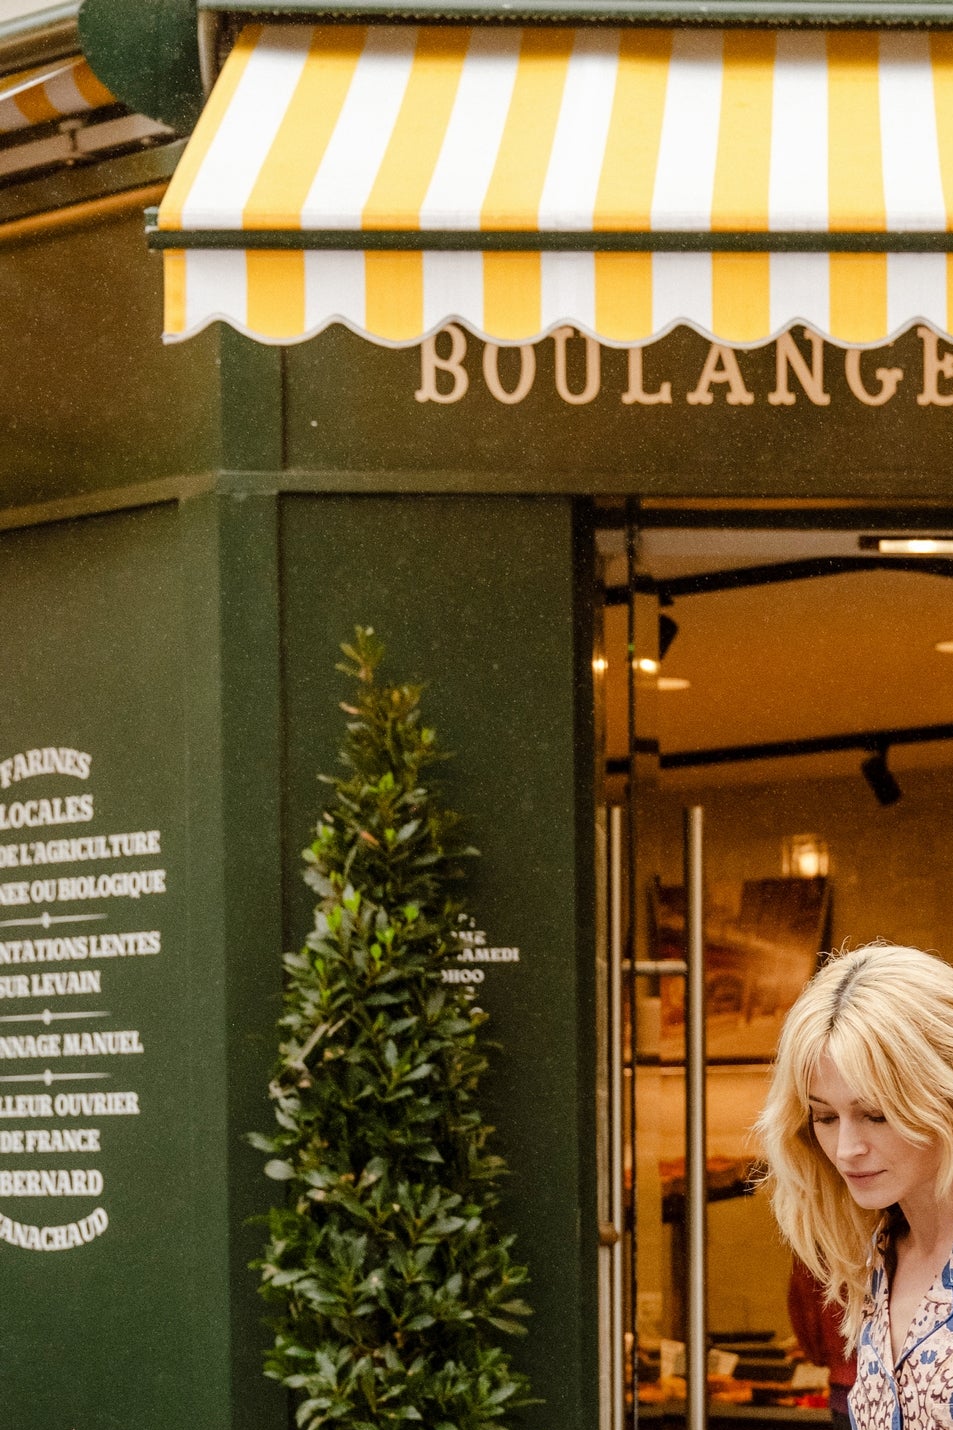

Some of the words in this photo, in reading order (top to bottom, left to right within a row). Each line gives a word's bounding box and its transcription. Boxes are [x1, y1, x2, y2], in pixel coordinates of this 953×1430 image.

[0, 747, 92, 789] FARINES
[0, 794, 94, 830] LOCALES
[20, 830, 161, 866] L'AGRICULTURE
[31, 878, 57, 903] OU
[57, 869, 167, 901] BIOLOGIQUE
[89, 930, 161, 958] LENTES
[457, 947, 520, 962] AMEDI
[31, 970, 101, 996] LEVAIN
[63, 1030, 144, 1056] MANUEL
[54, 1091, 140, 1117] OUVRIER
[0, 1130, 24, 1153] DE
[25, 1128, 101, 1152] FRANCE
[0, 1169, 104, 1197] BERNARD
[0, 1207, 109, 1251] ANACHAUD
